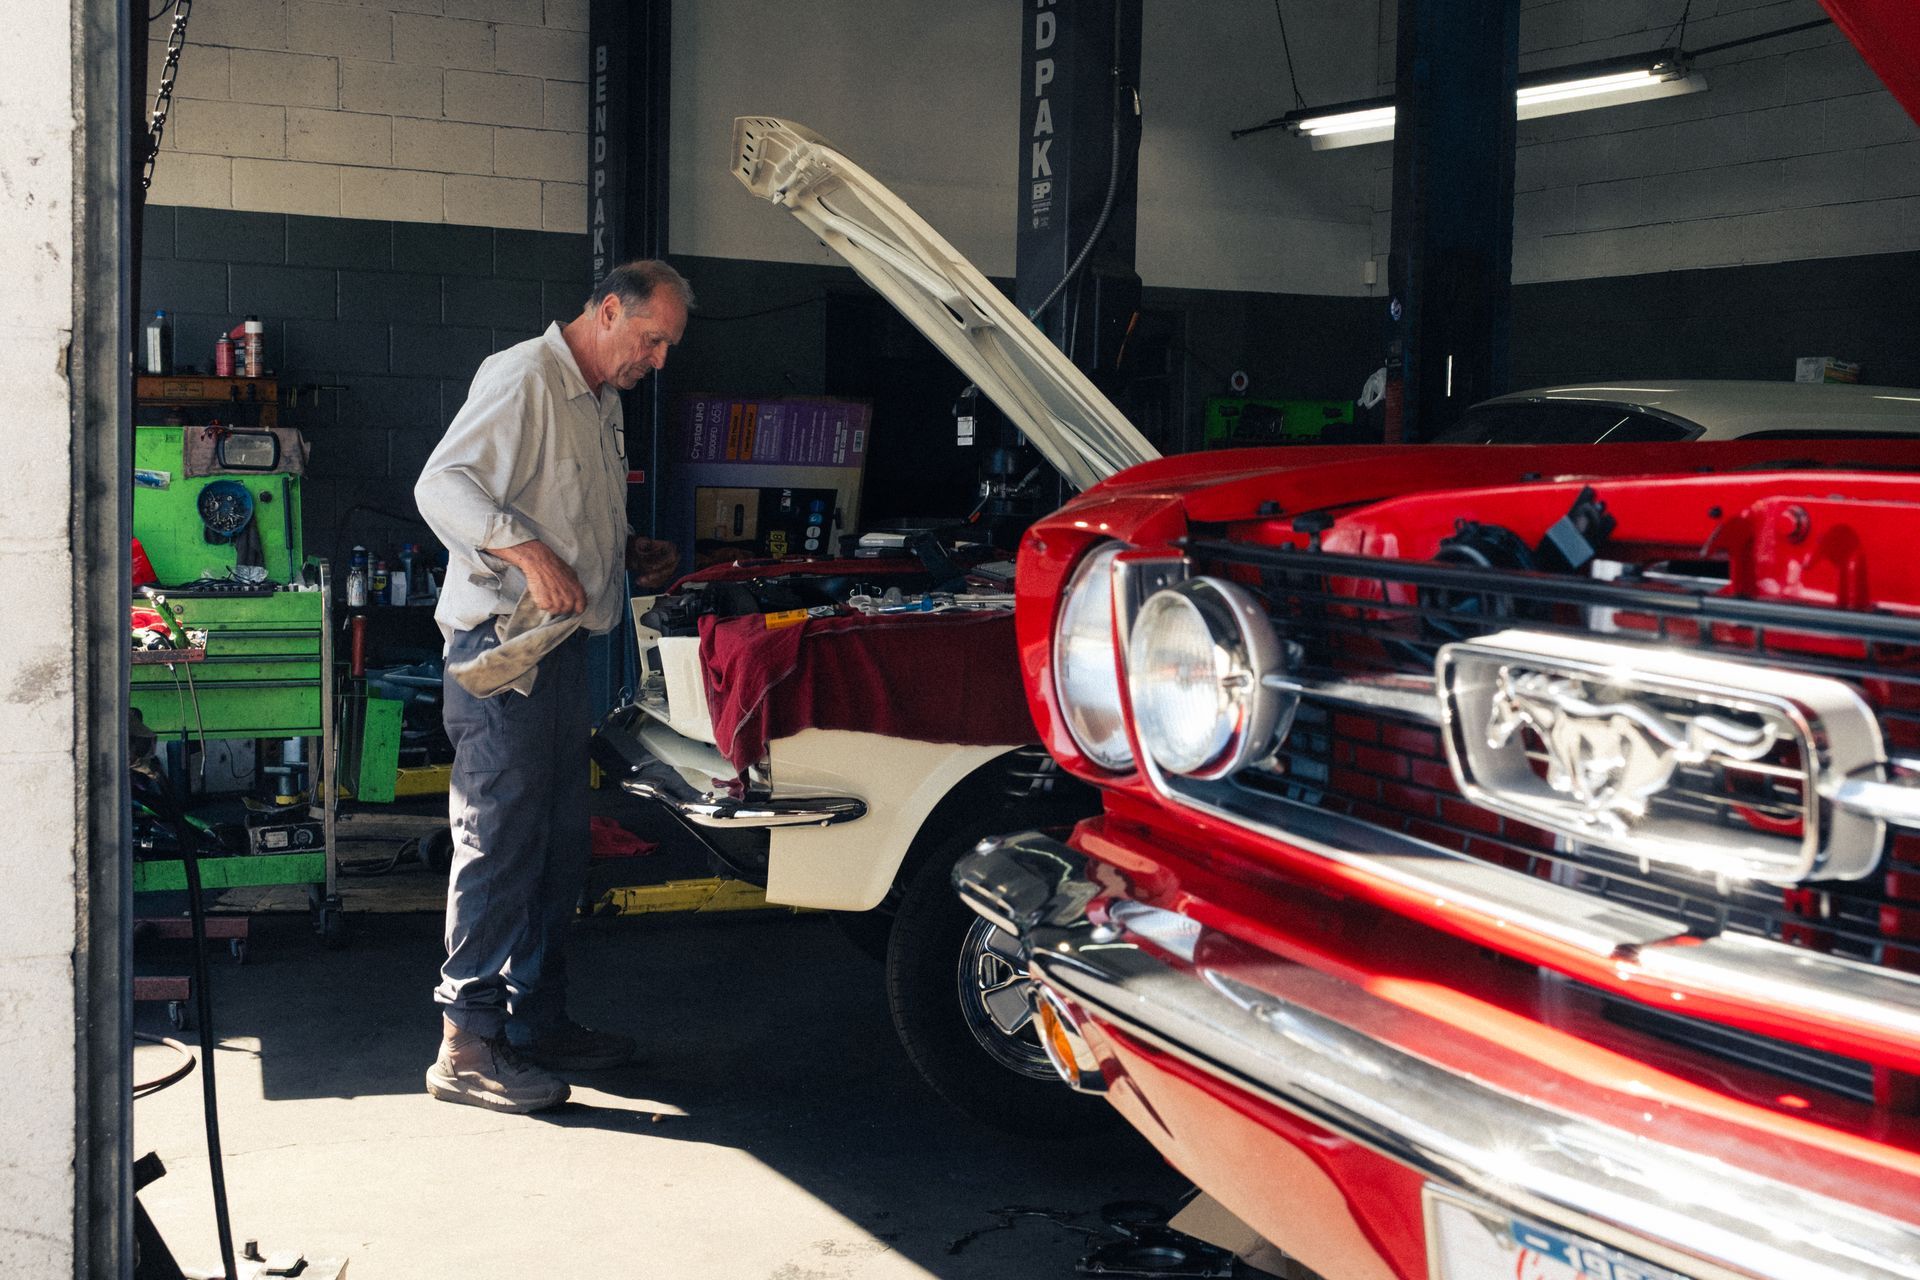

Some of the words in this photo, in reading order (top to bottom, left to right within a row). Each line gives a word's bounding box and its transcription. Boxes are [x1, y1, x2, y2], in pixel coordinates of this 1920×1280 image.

[1032, 0, 1057, 178] DPAK
[695, 402, 705, 422] UHD
[691, 423, 703, 459] Crystal
